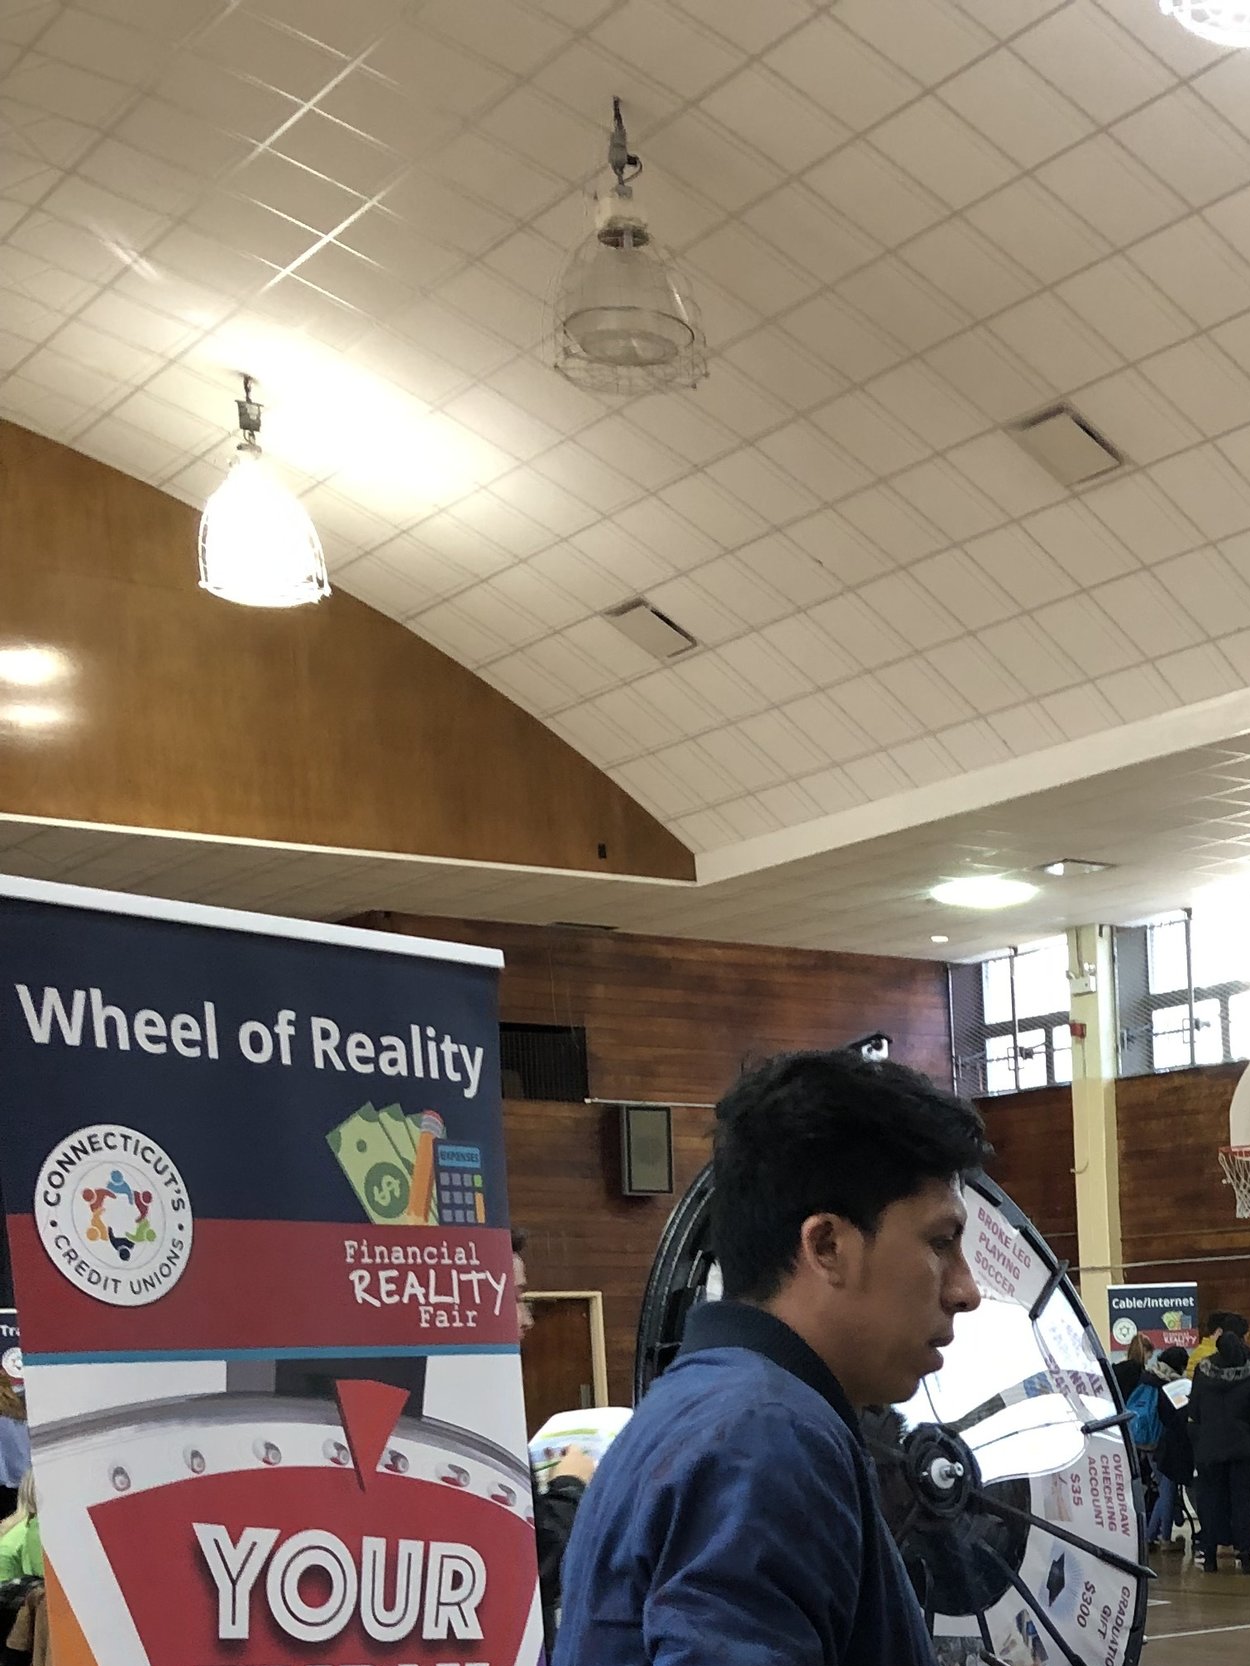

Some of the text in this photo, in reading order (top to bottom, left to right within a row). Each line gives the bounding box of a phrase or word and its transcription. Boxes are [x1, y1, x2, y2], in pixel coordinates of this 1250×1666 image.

[15, 983, 484, 1099] Wheel of Reality
[43, 1132, 186, 1211] CONNECTICUT'S
[54, 1234, 184, 1295] CREDIT UNIONS
[344, 1239, 480, 1266] Financial
[977, 1207, 1032, 1269] BROKE LEG
[978, 1231, 1021, 1280] PLAYING
[349, 1268, 507, 1316] REALITY
[974, 1250, 1016, 1297] SOCCER
[419, 1304, 478, 1328] Fair
[1112, 1296, 1195, 1309] Cable/Internet
[1087, 1456, 1104, 1528] ACCOUNT
[1100, 1454, 1117, 1532] CHECKING
[1112, 1453, 1131, 1537] OVERDRAW
[192, 1522, 487, 1643] YOUR
[1076, 1581, 1096, 1628] $300
[1097, 1604, 1112, 1640] GIFT
